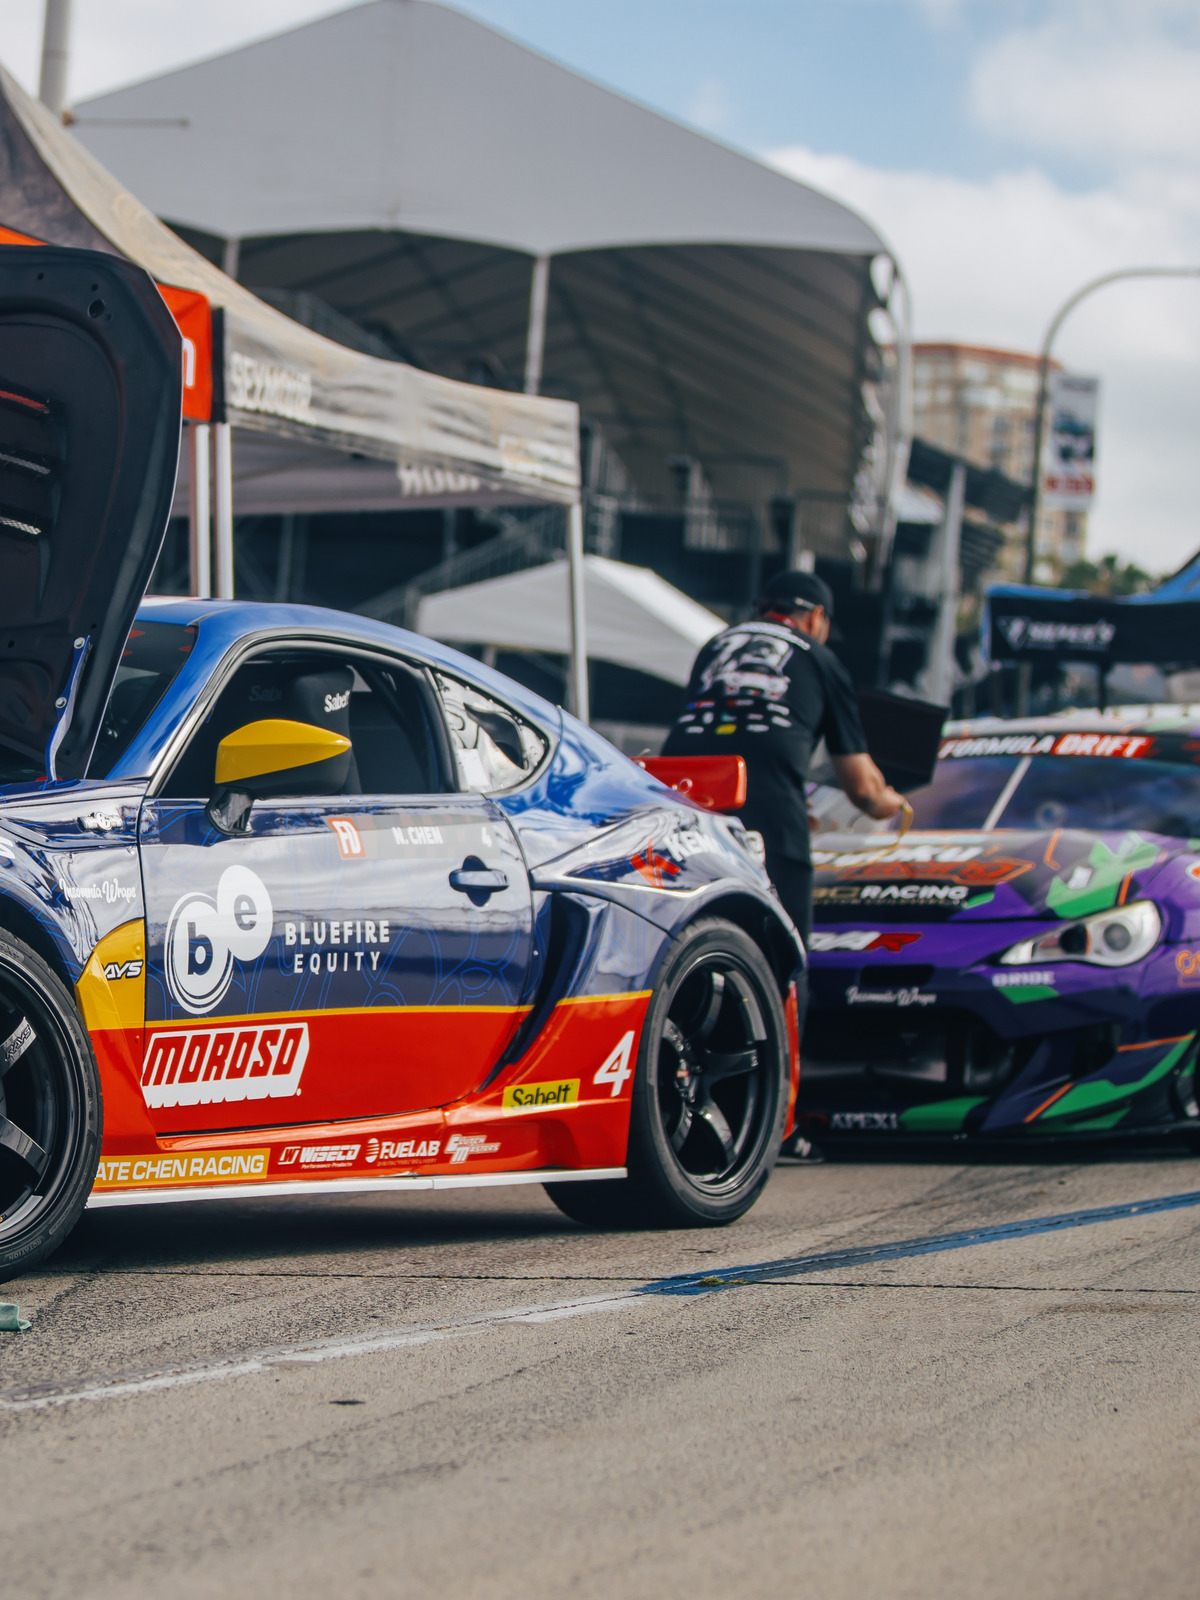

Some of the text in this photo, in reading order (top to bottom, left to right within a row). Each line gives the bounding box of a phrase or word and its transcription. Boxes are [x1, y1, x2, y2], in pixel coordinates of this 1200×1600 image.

[938, 734, 1148, 759] FORMULA DRIFT
[408, 826, 444, 844] CHEN
[59, 878, 136, 903] Insomnia Wraps
[861, 885, 969, 899] RACING
[285, 920, 390, 945] BLUEFIRE
[294, 951, 381, 975] EQUITY
[142, 1026, 307, 1090] MOROSO
[593, 1030, 635, 1097] 4
[512, 1084, 571, 1111] Sabelt
[132, 1157, 189, 1179] CHEN
[190, 1154, 266, 1177] RACING
